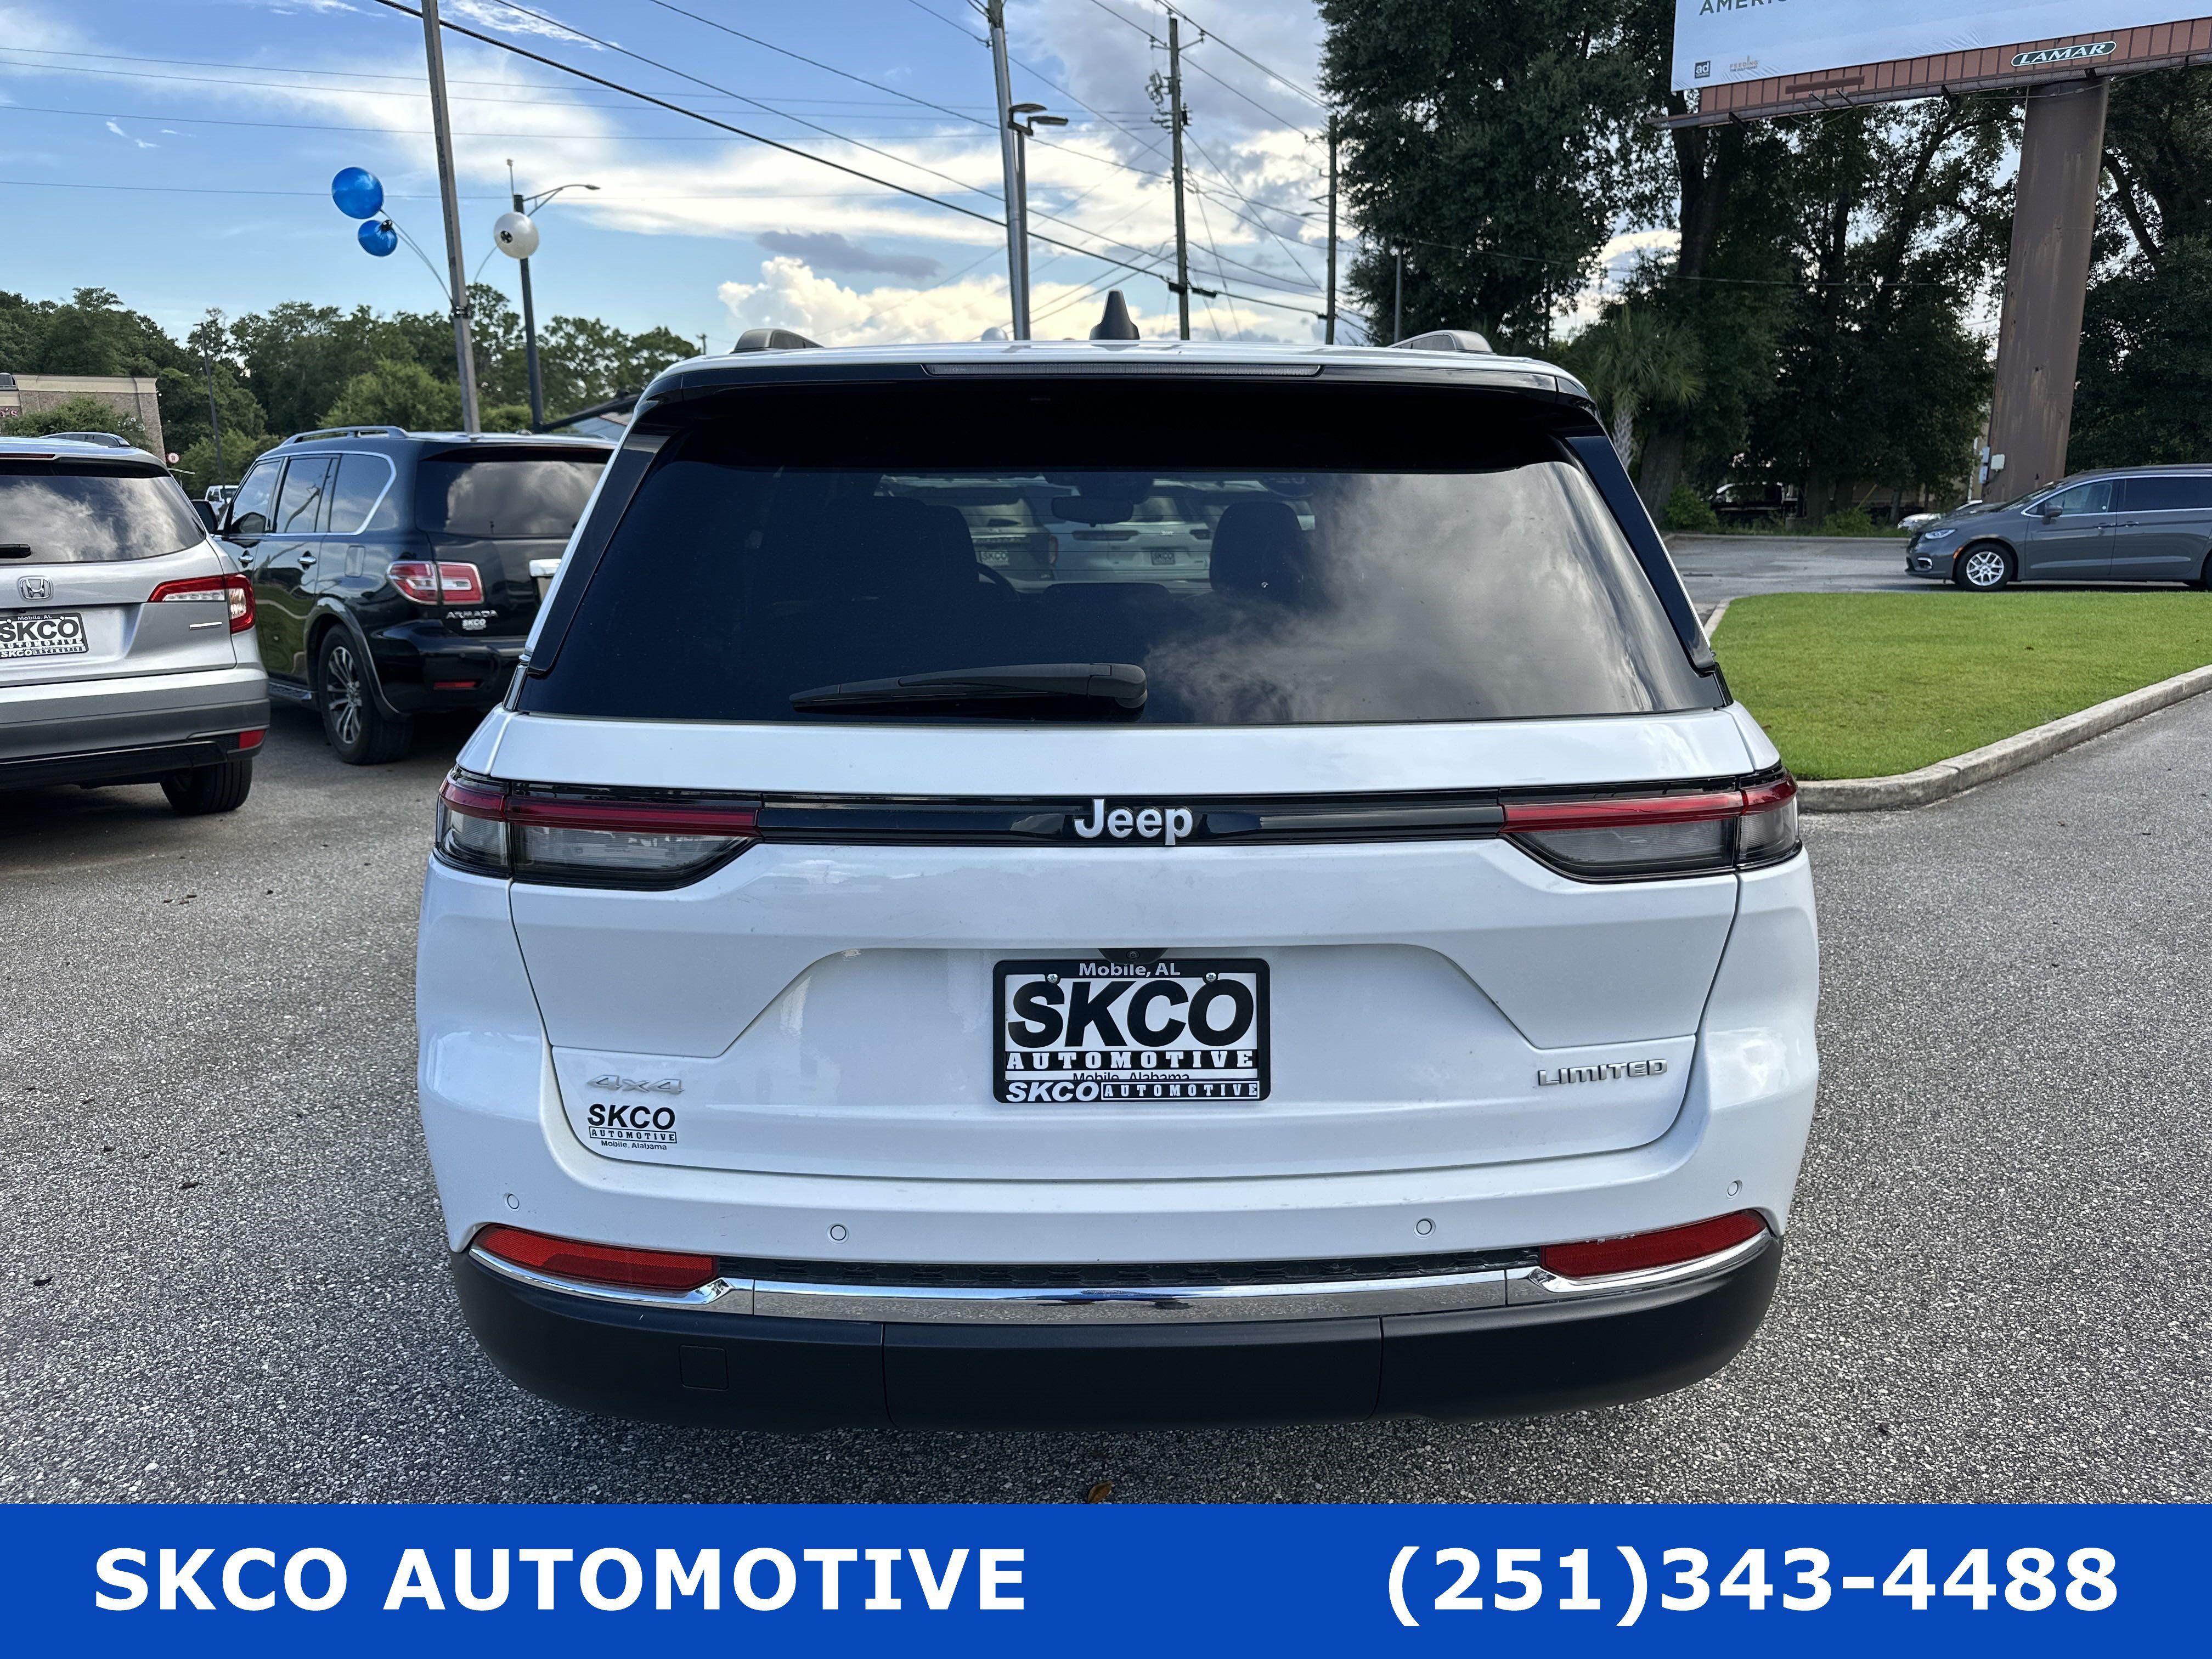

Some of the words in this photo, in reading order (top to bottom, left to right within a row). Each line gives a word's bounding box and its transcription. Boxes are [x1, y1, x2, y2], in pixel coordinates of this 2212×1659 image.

[2019, 44, 2106, 64] LAMAR
[1696, 62, 1709, 74] ad
[0, 619, 79, 642] SKCO
[1, 650, 33, 658] SKCO
[1074, 799, 1193, 845] Jeep
[1079, 963, 1151, 977] Mobile,
[1155, 962, 1181, 975] AL
[1008, 979, 1254, 1048] SKCO
[1007, 1050, 1254, 1069] AUTOMOTIVE
[1538, 1059, 1668, 1086] LIMITED
[587, 1074, 685, 1094] 4x4
[1006, 1081, 1099, 1102] SKCO
[1104, 1084, 1258, 1097] AUTOMOTIVE
[587, 1103, 675, 1130] SKCO
[591, 1129, 675, 1141] AUTOMOTIVE
